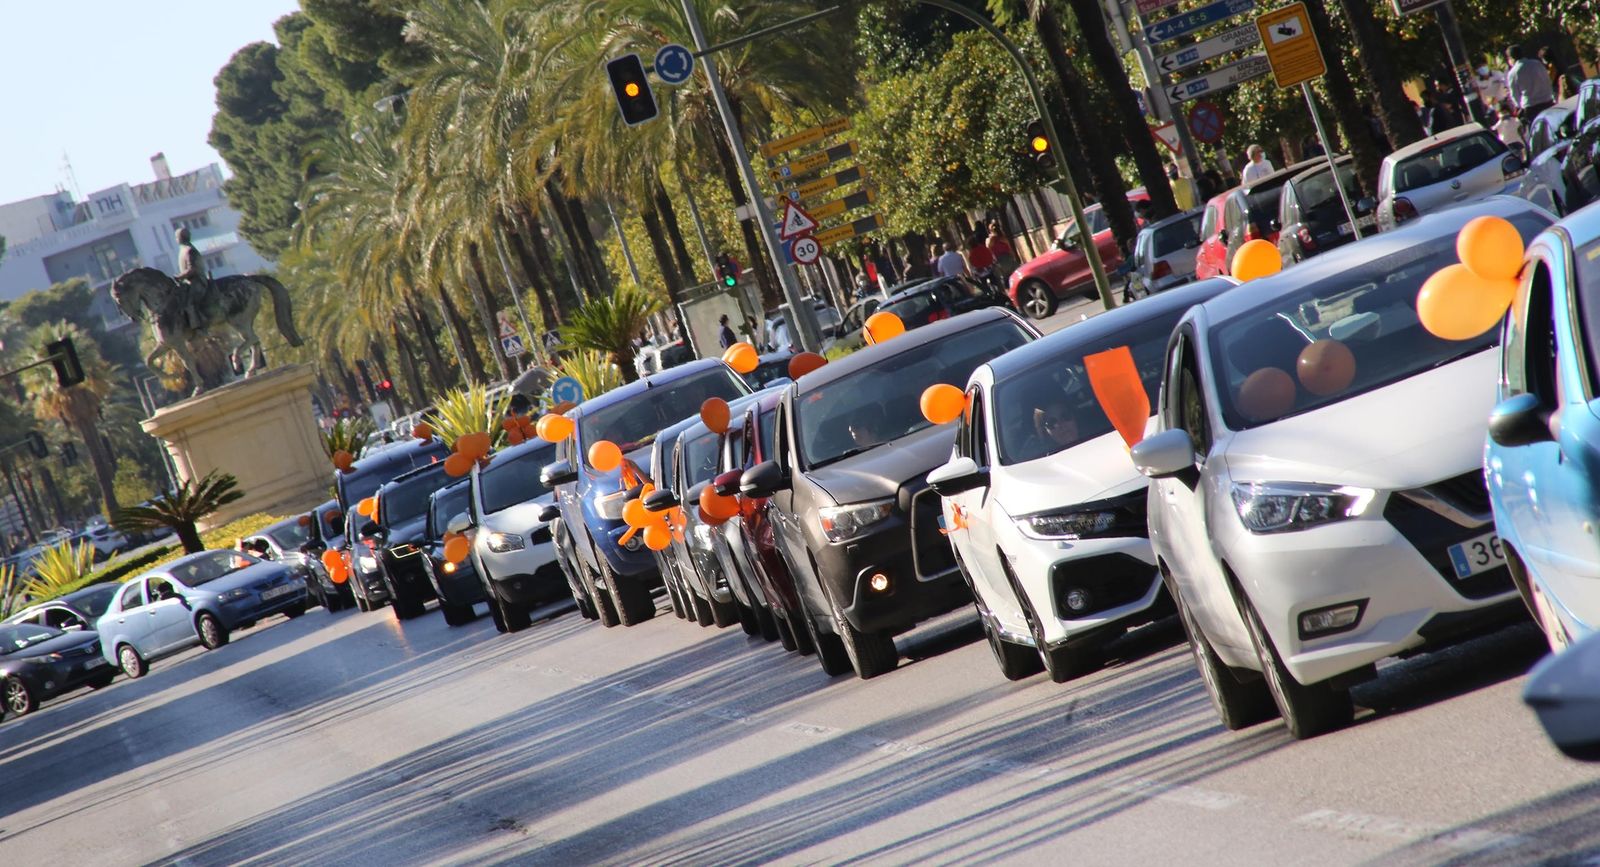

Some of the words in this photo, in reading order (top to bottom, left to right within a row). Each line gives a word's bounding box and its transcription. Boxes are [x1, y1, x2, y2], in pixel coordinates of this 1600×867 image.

[1167, 21, 1185, 32] A-4
[1188, 13, 1206, 24] E-5
[797, 243, 815, 257] 30
